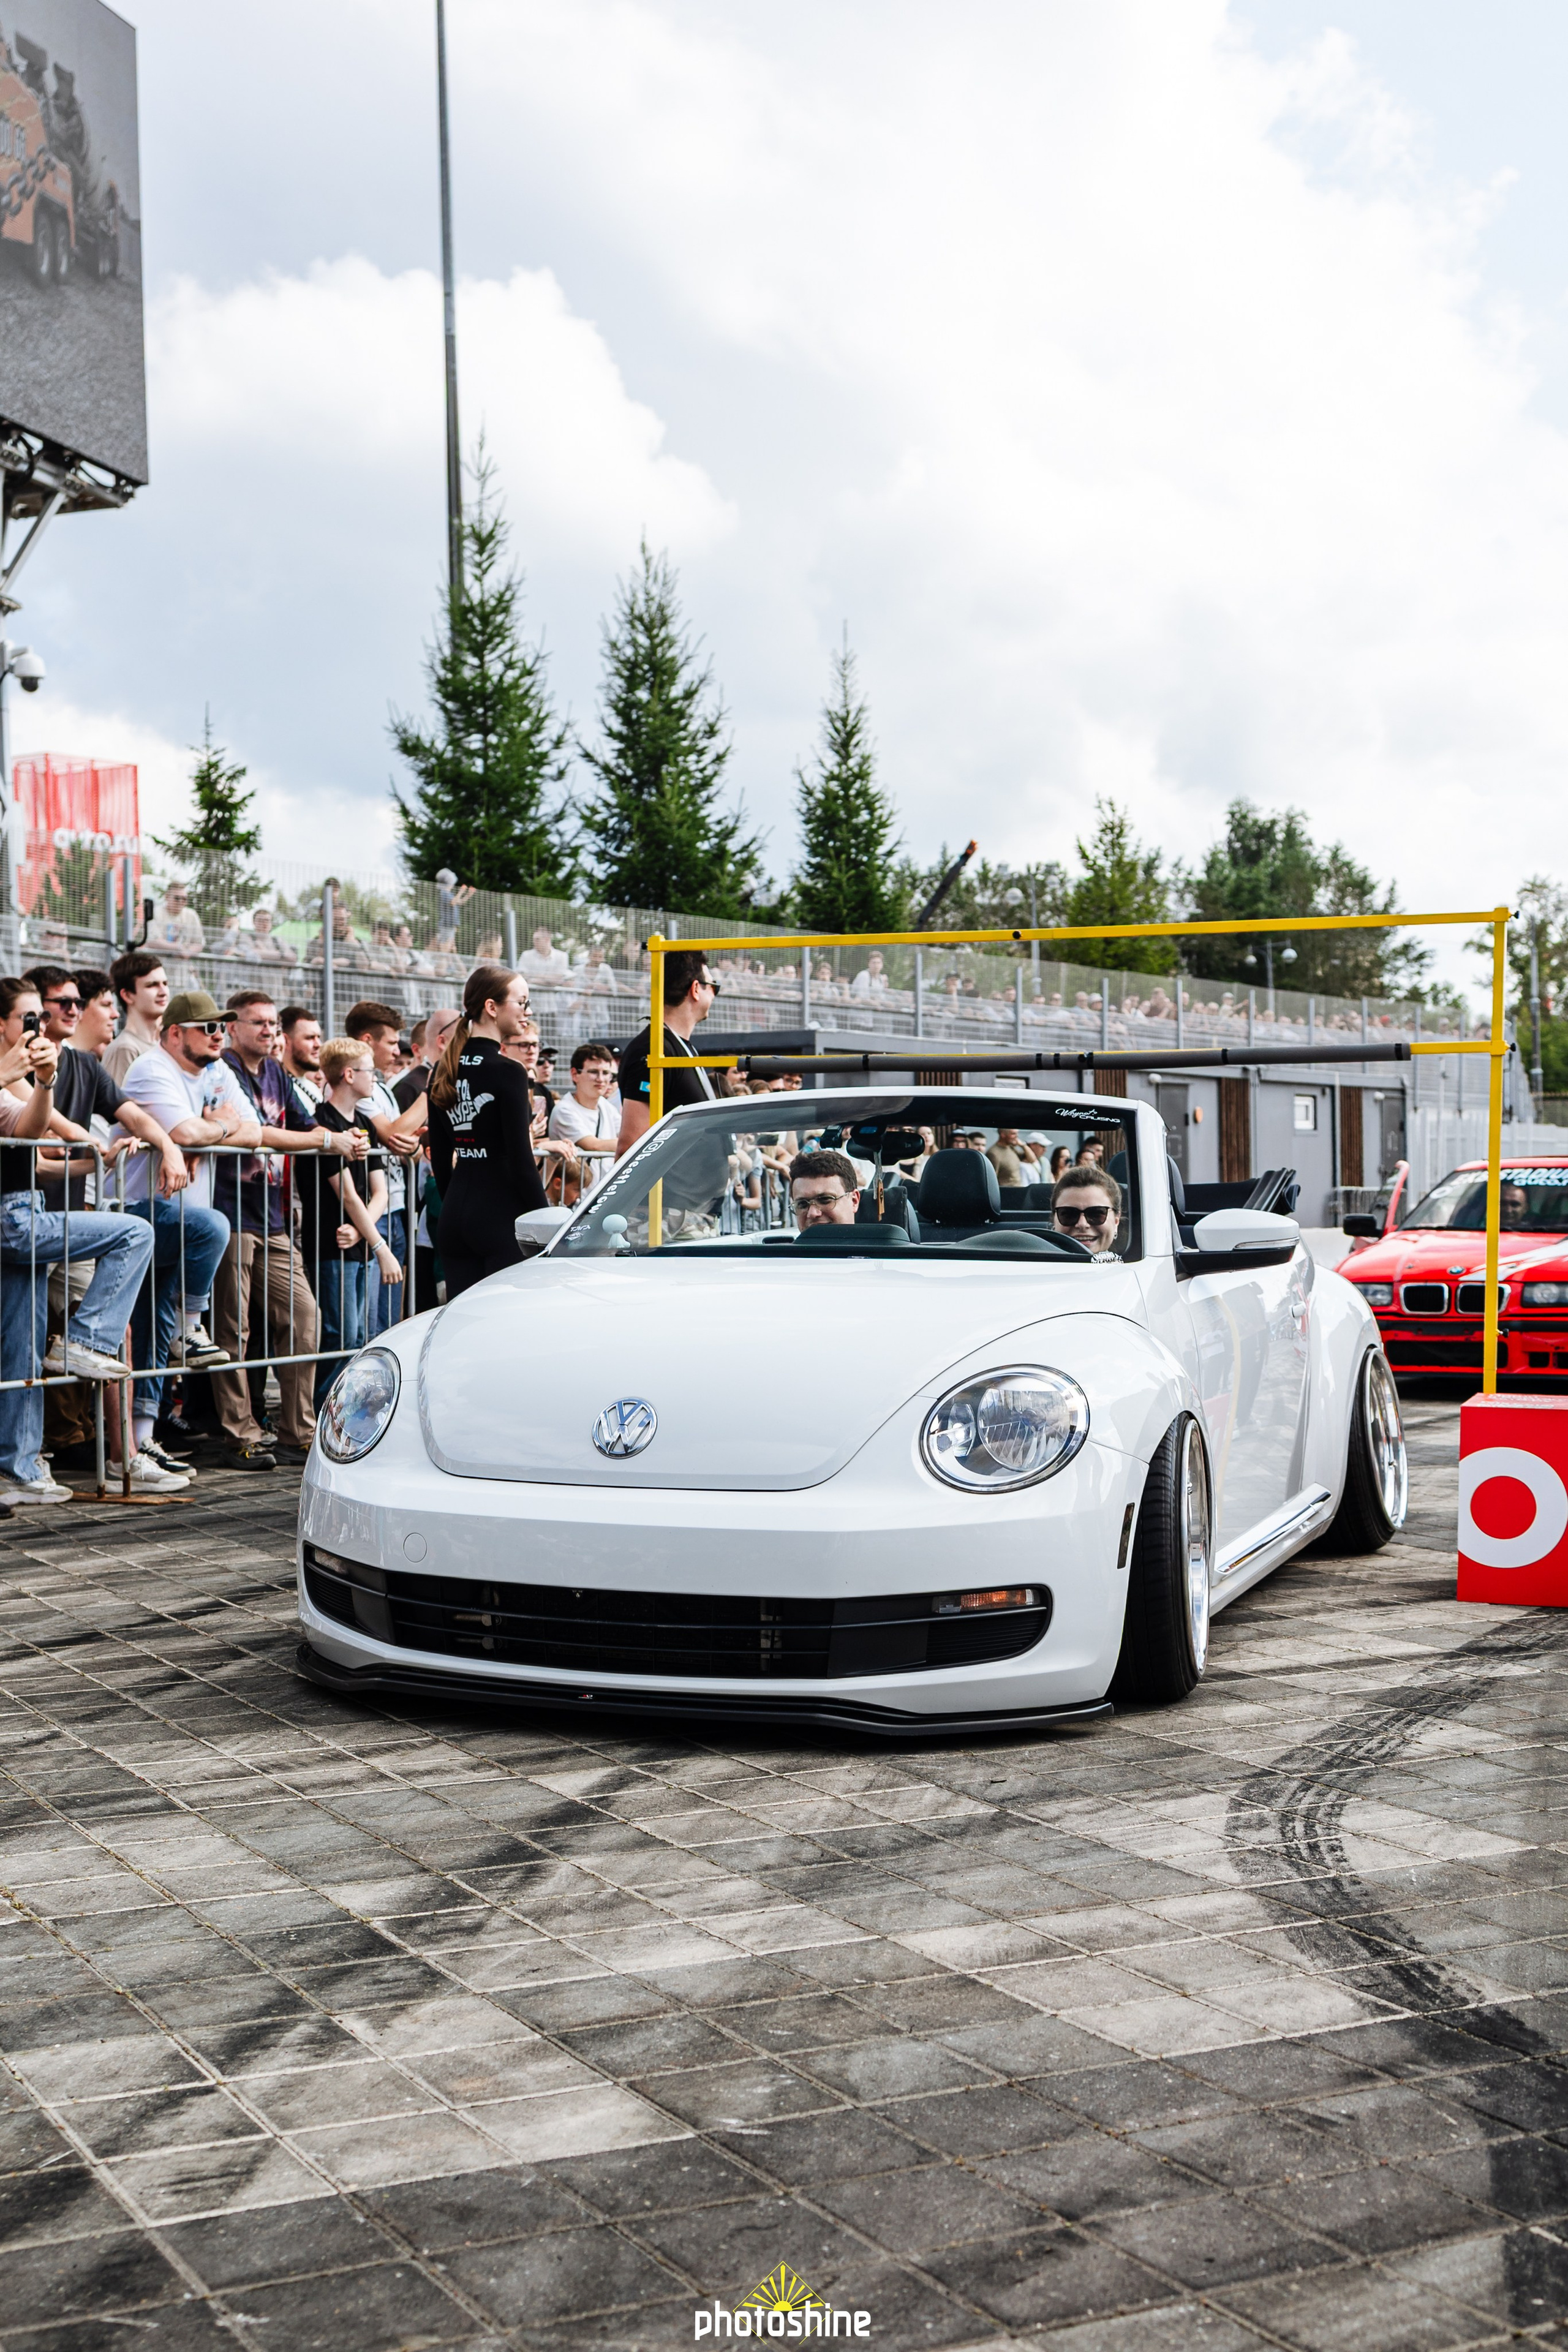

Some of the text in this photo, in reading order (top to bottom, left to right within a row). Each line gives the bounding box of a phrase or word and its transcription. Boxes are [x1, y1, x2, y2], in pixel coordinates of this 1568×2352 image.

[459, 1055, 484, 1065] RLS
[446, 1100, 478, 1125] HYPE
[1079, 1115, 1121, 1123] CRUISING
[455, 1147, 488, 1158] TEAM
[1500, 1168, 1568, 1180] STADIU
[588, 1153, 652, 1214] beetlelow
[1513, 1178, 1568, 1186] auto.r
